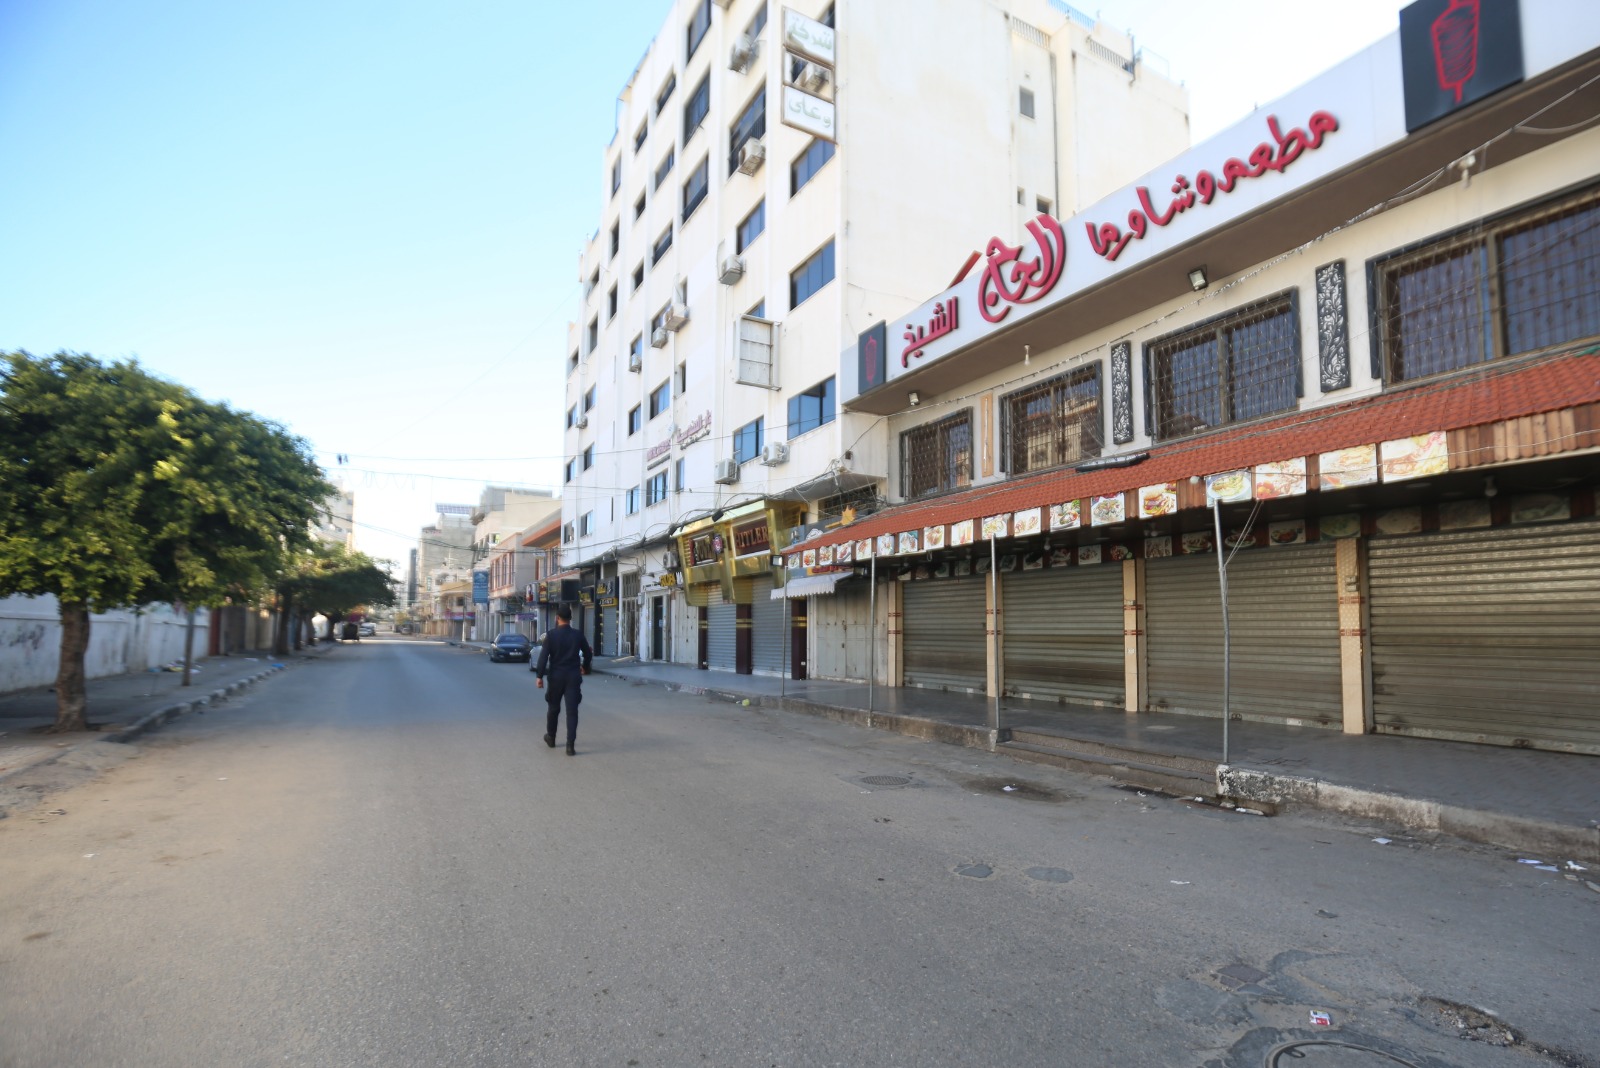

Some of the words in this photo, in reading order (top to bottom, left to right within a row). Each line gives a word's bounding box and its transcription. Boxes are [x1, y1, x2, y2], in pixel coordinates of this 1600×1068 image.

[1217, 110, 1338, 193] مطعم
[978, 213, 1066, 323] الحاج
[901, 296, 959, 368] الشيخ
